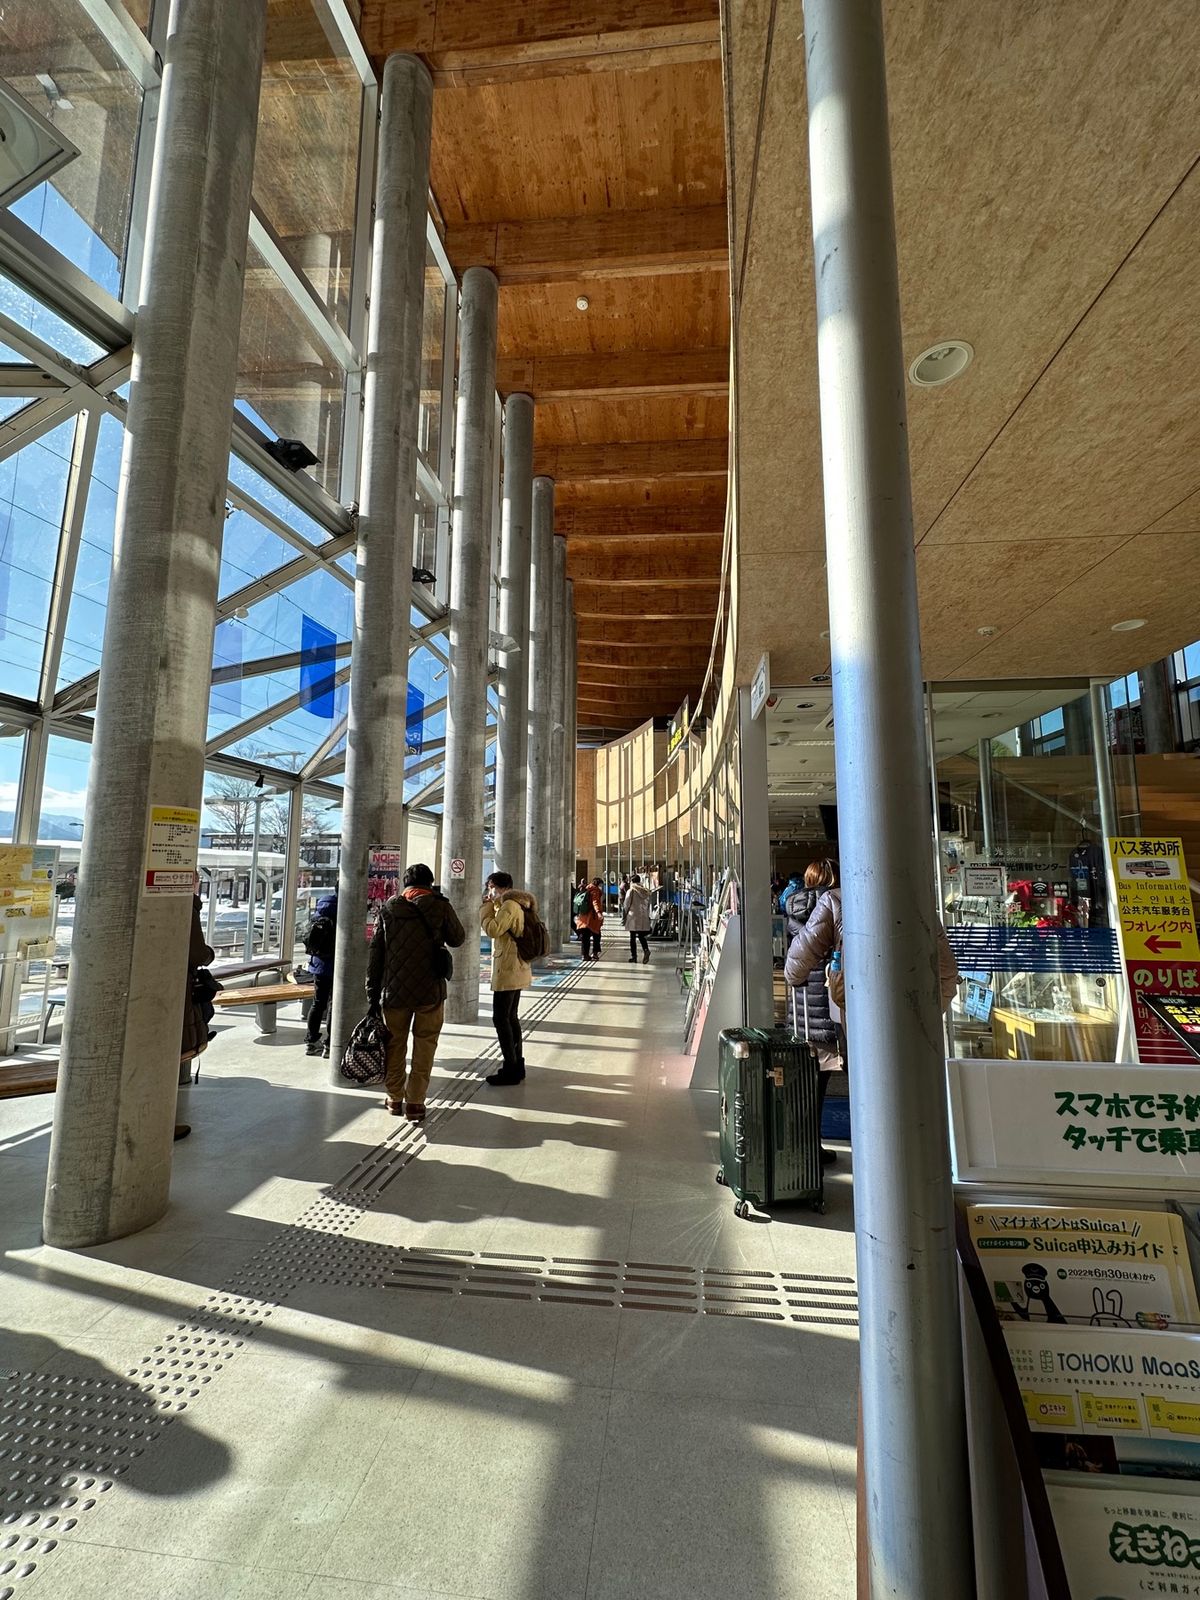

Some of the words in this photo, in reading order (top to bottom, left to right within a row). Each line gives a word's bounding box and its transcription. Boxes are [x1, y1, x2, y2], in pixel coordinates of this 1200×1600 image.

[1114, 841, 1180, 856] バス案内所
[1119, 882, 1131, 890] Bus
[1136, 882, 1187, 891] Information
[1122, 906, 1190, 916] 公共汽车服务台
[1123, 921, 1193, 933] フォレイク内
[1133, 968, 1200, 989] のりば
[1033, 1236, 1165, 1259] Suica申込みガイド
[1057, 1353, 1134, 1374] TOHOKU
[1142, 1356, 1200, 1379] MaaS
